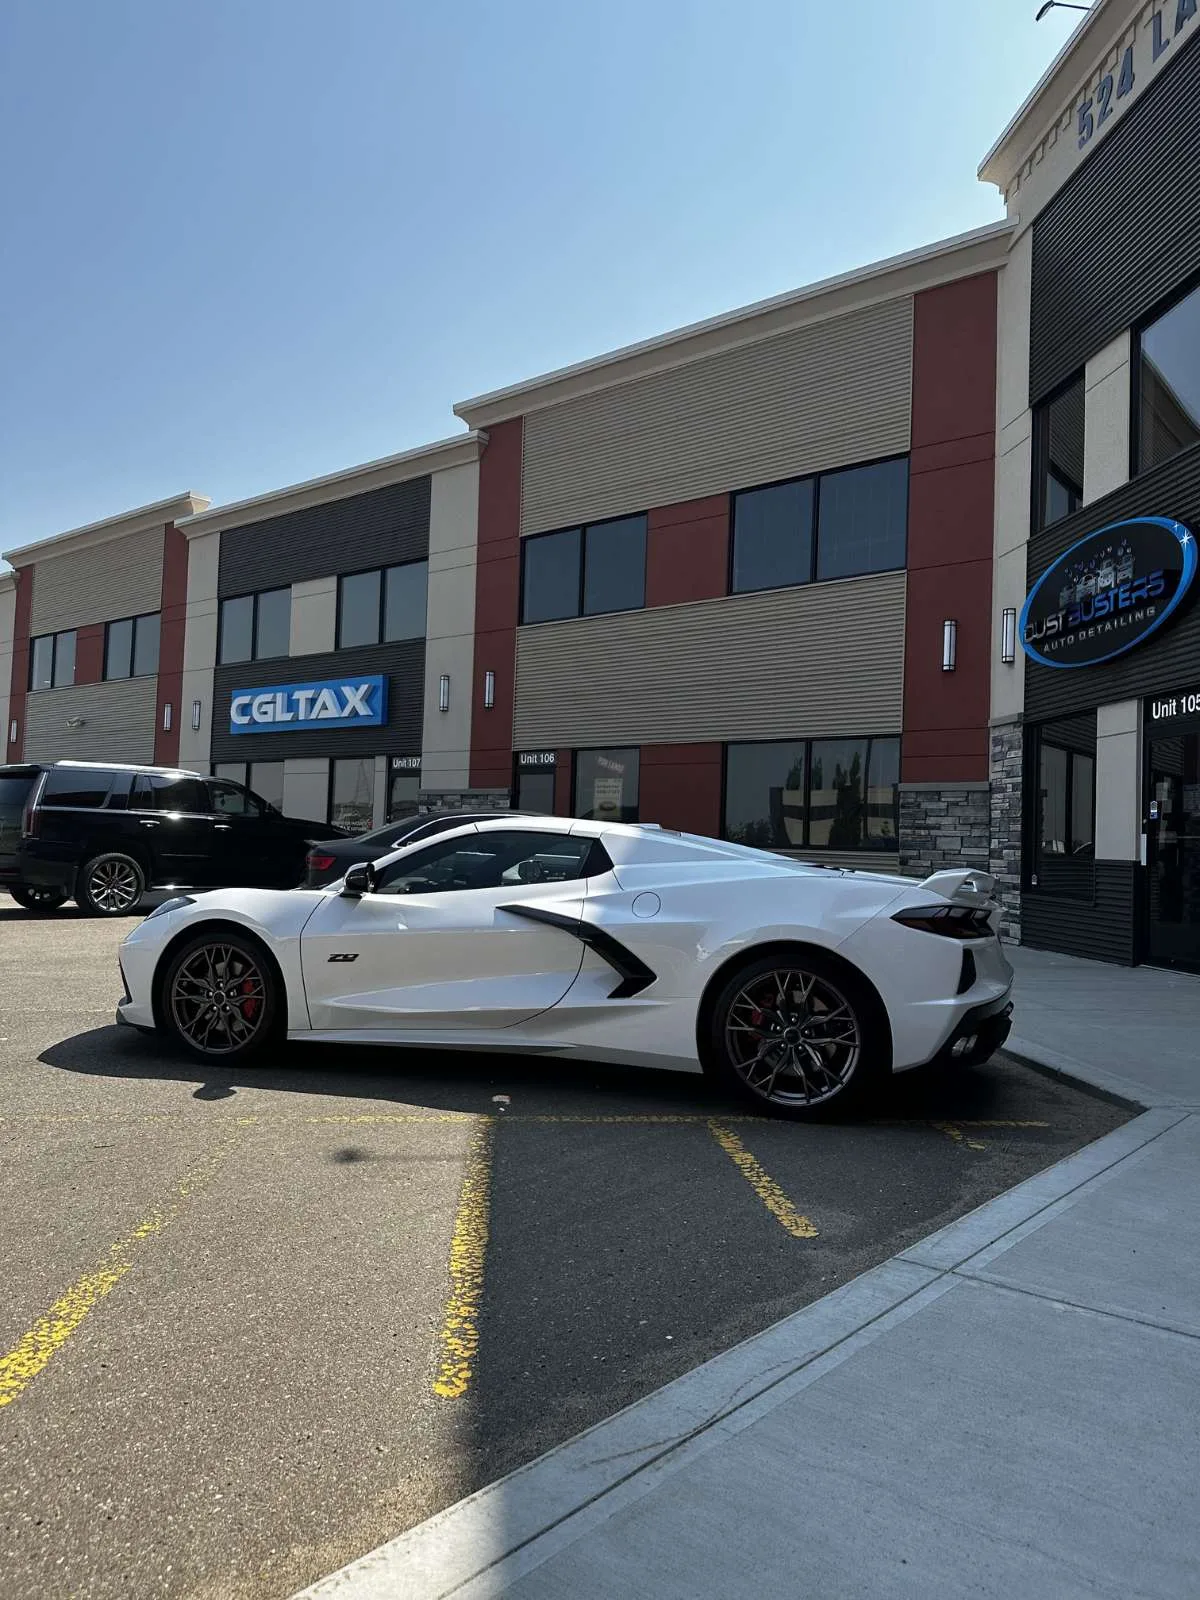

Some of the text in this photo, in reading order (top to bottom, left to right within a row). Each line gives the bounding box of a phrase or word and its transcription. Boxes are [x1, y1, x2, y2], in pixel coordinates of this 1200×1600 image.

[1077, 46, 1135, 150] 524
[1023, 611, 1065, 643] DUST
[1044, 605, 1156, 652] AUTO DETAILING
[1152, 699, 1177, 719] Unit
[393, 758, 421, 768] Unit 107
[520, 753, 555, 764] Unit 106
